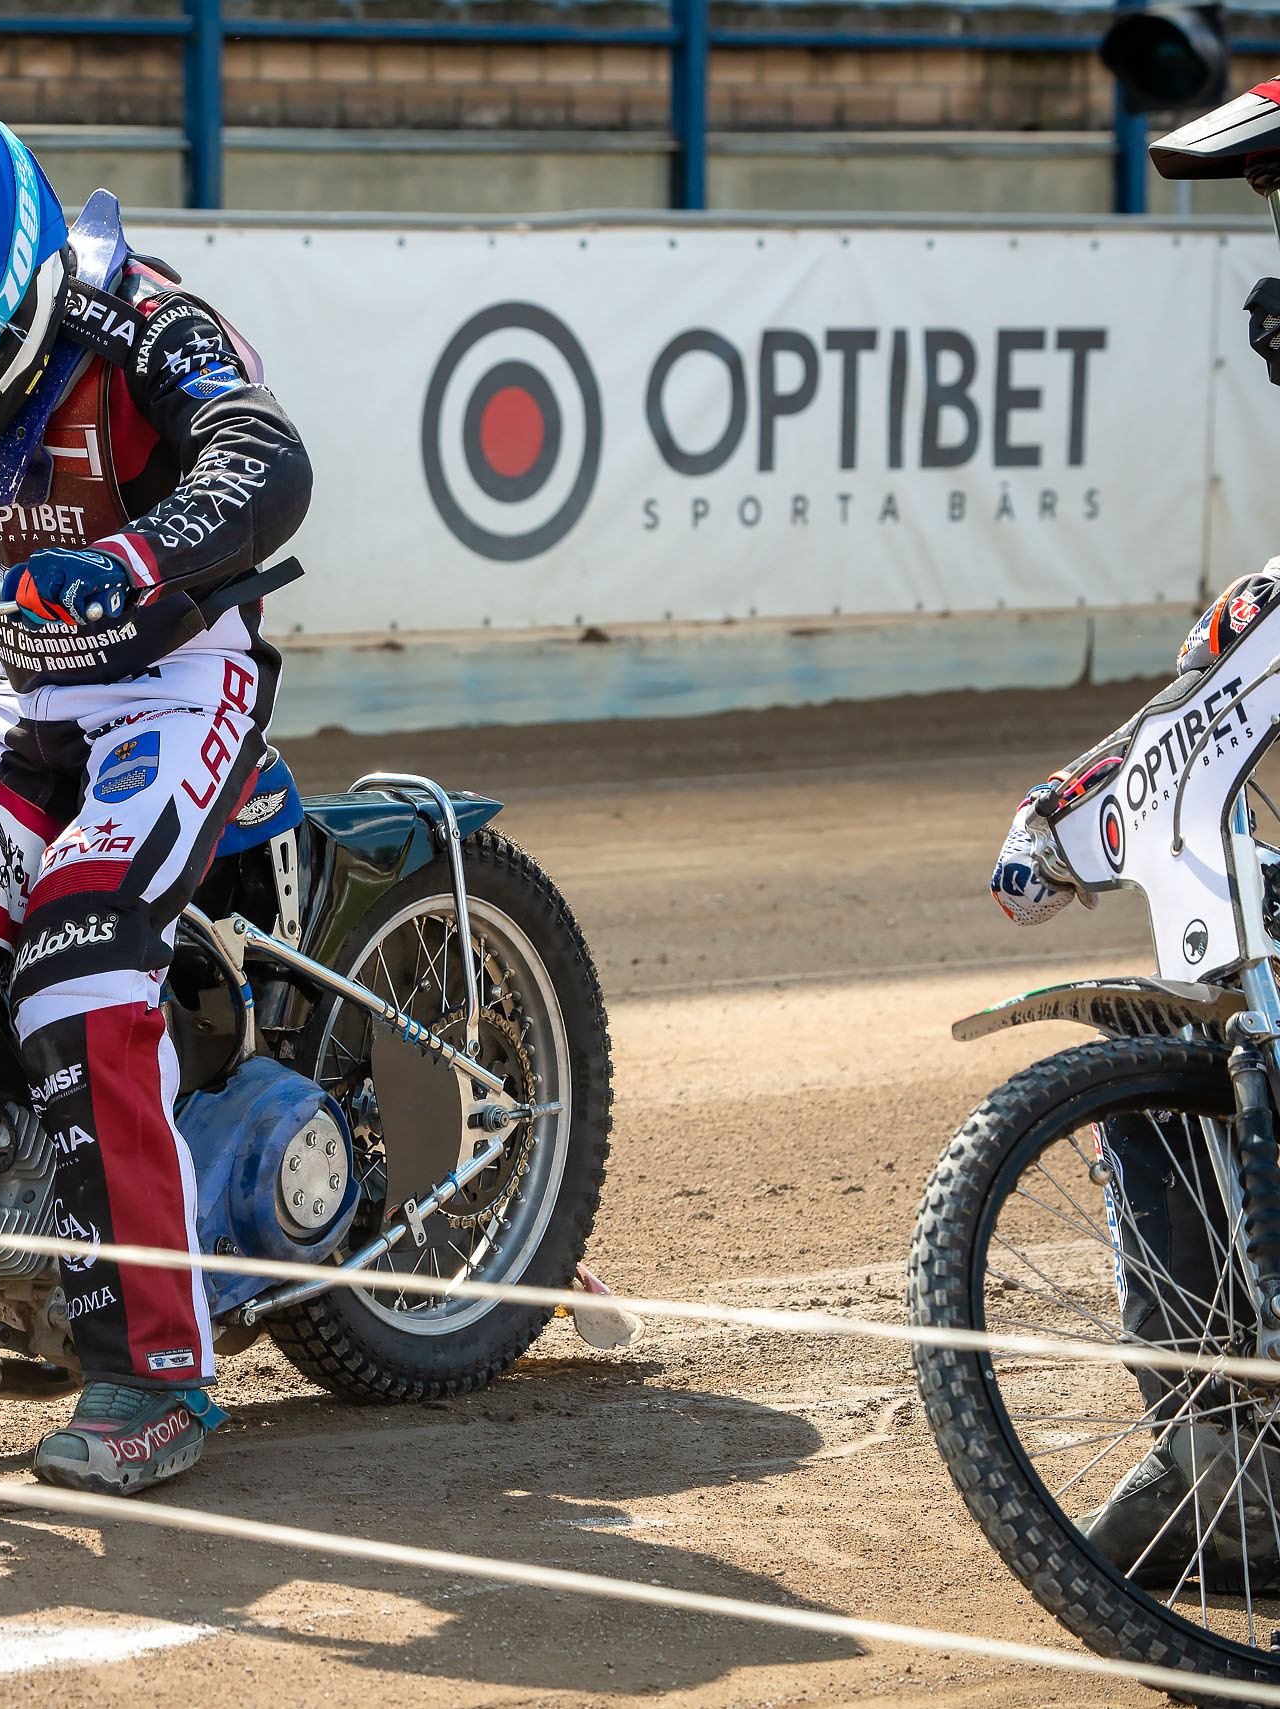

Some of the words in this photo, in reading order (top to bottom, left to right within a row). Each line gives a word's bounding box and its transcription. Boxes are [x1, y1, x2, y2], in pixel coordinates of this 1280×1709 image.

[645, 327, 1108, 476] OPTIBET
[642, 493, 901, 531] SPORTA
[947, 481, 1101, 523] BĀRS
[45, 651, 96, 671] Round
[98, 650, 108, 664] 1
[1126, 676, 1248, 812] OPTIBET
[1134, 776, 1193, 831] SPORT
[1202, 727, 1254, 767] BĀRS
